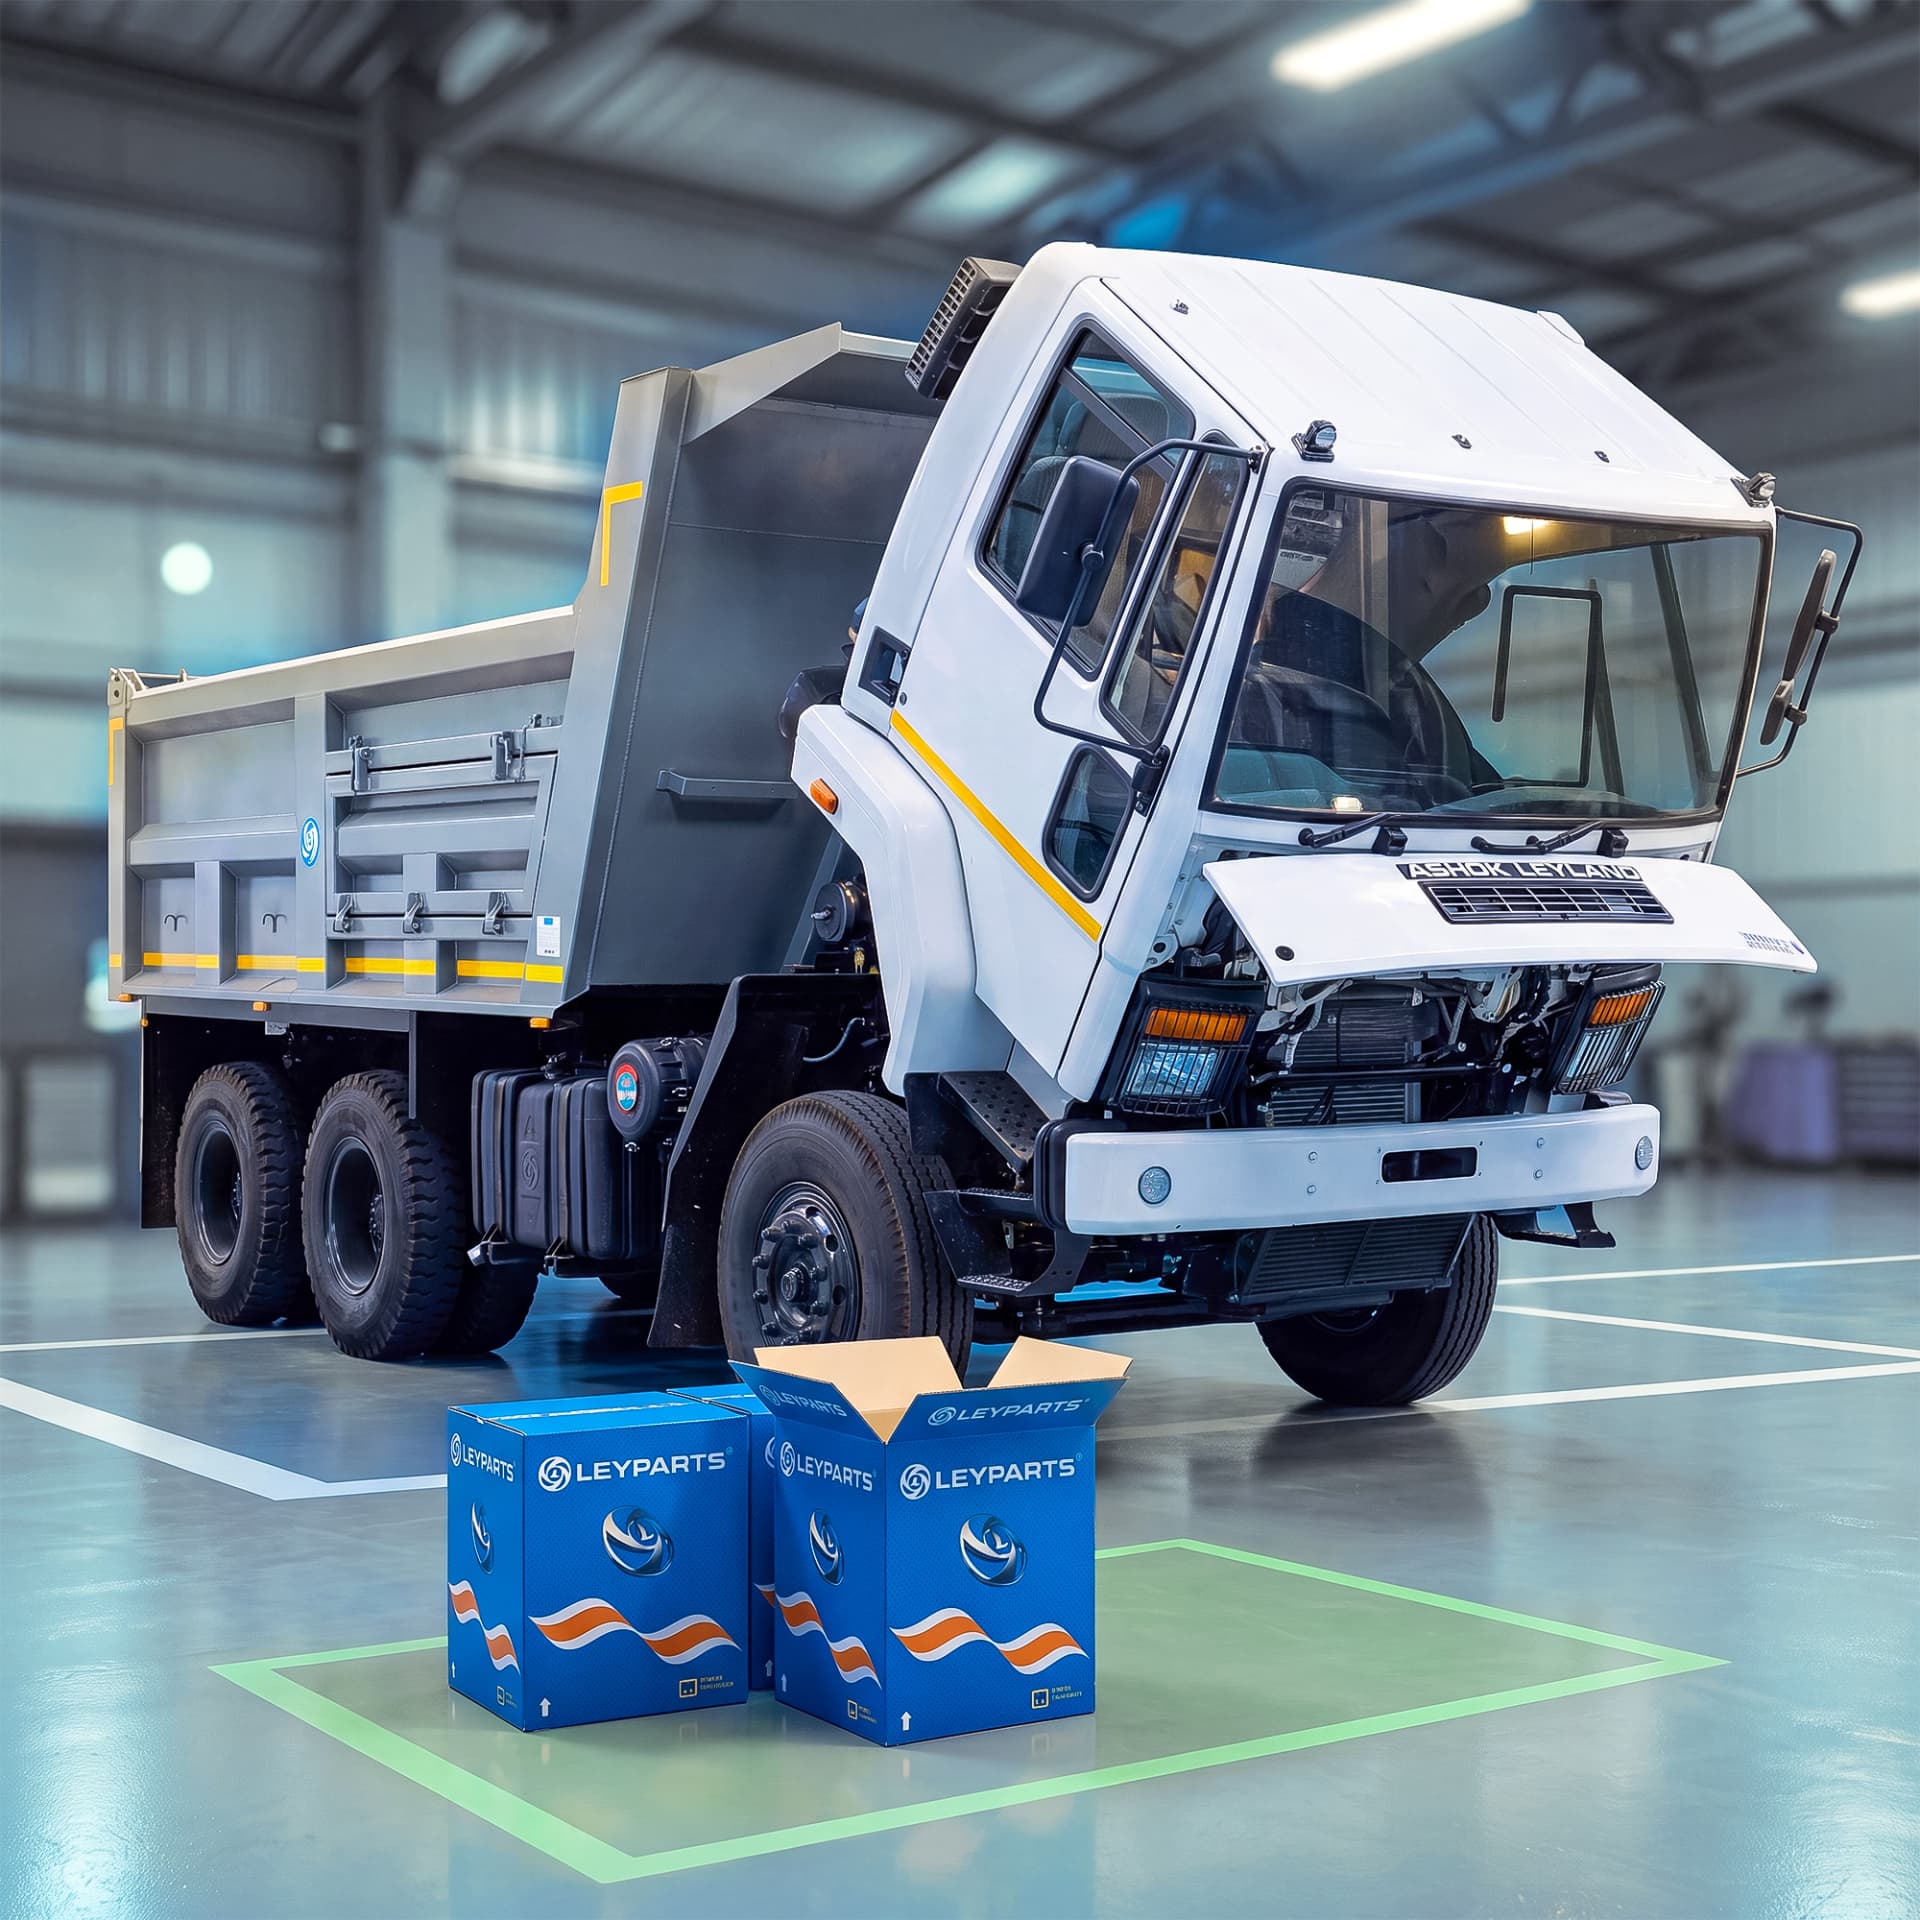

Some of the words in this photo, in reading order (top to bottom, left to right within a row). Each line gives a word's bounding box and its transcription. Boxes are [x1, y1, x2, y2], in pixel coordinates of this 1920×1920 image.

[1408, 862, 1512, 878] ASHOK
[1513, 862, 1642, 880] LEYLAND
[773, 1390, 847, 1417] LEYPARTS
[957, 1399, 1083, 1421] LEYPARTS
[463, 1443, 514, 1482] LEYPARTS
[576, 1452, 726, 1482] LEYPARTS
[797, 1453, 873, 1492] LEYPARTS
[936, 1458, 1075, 1489] LEYPARTS
